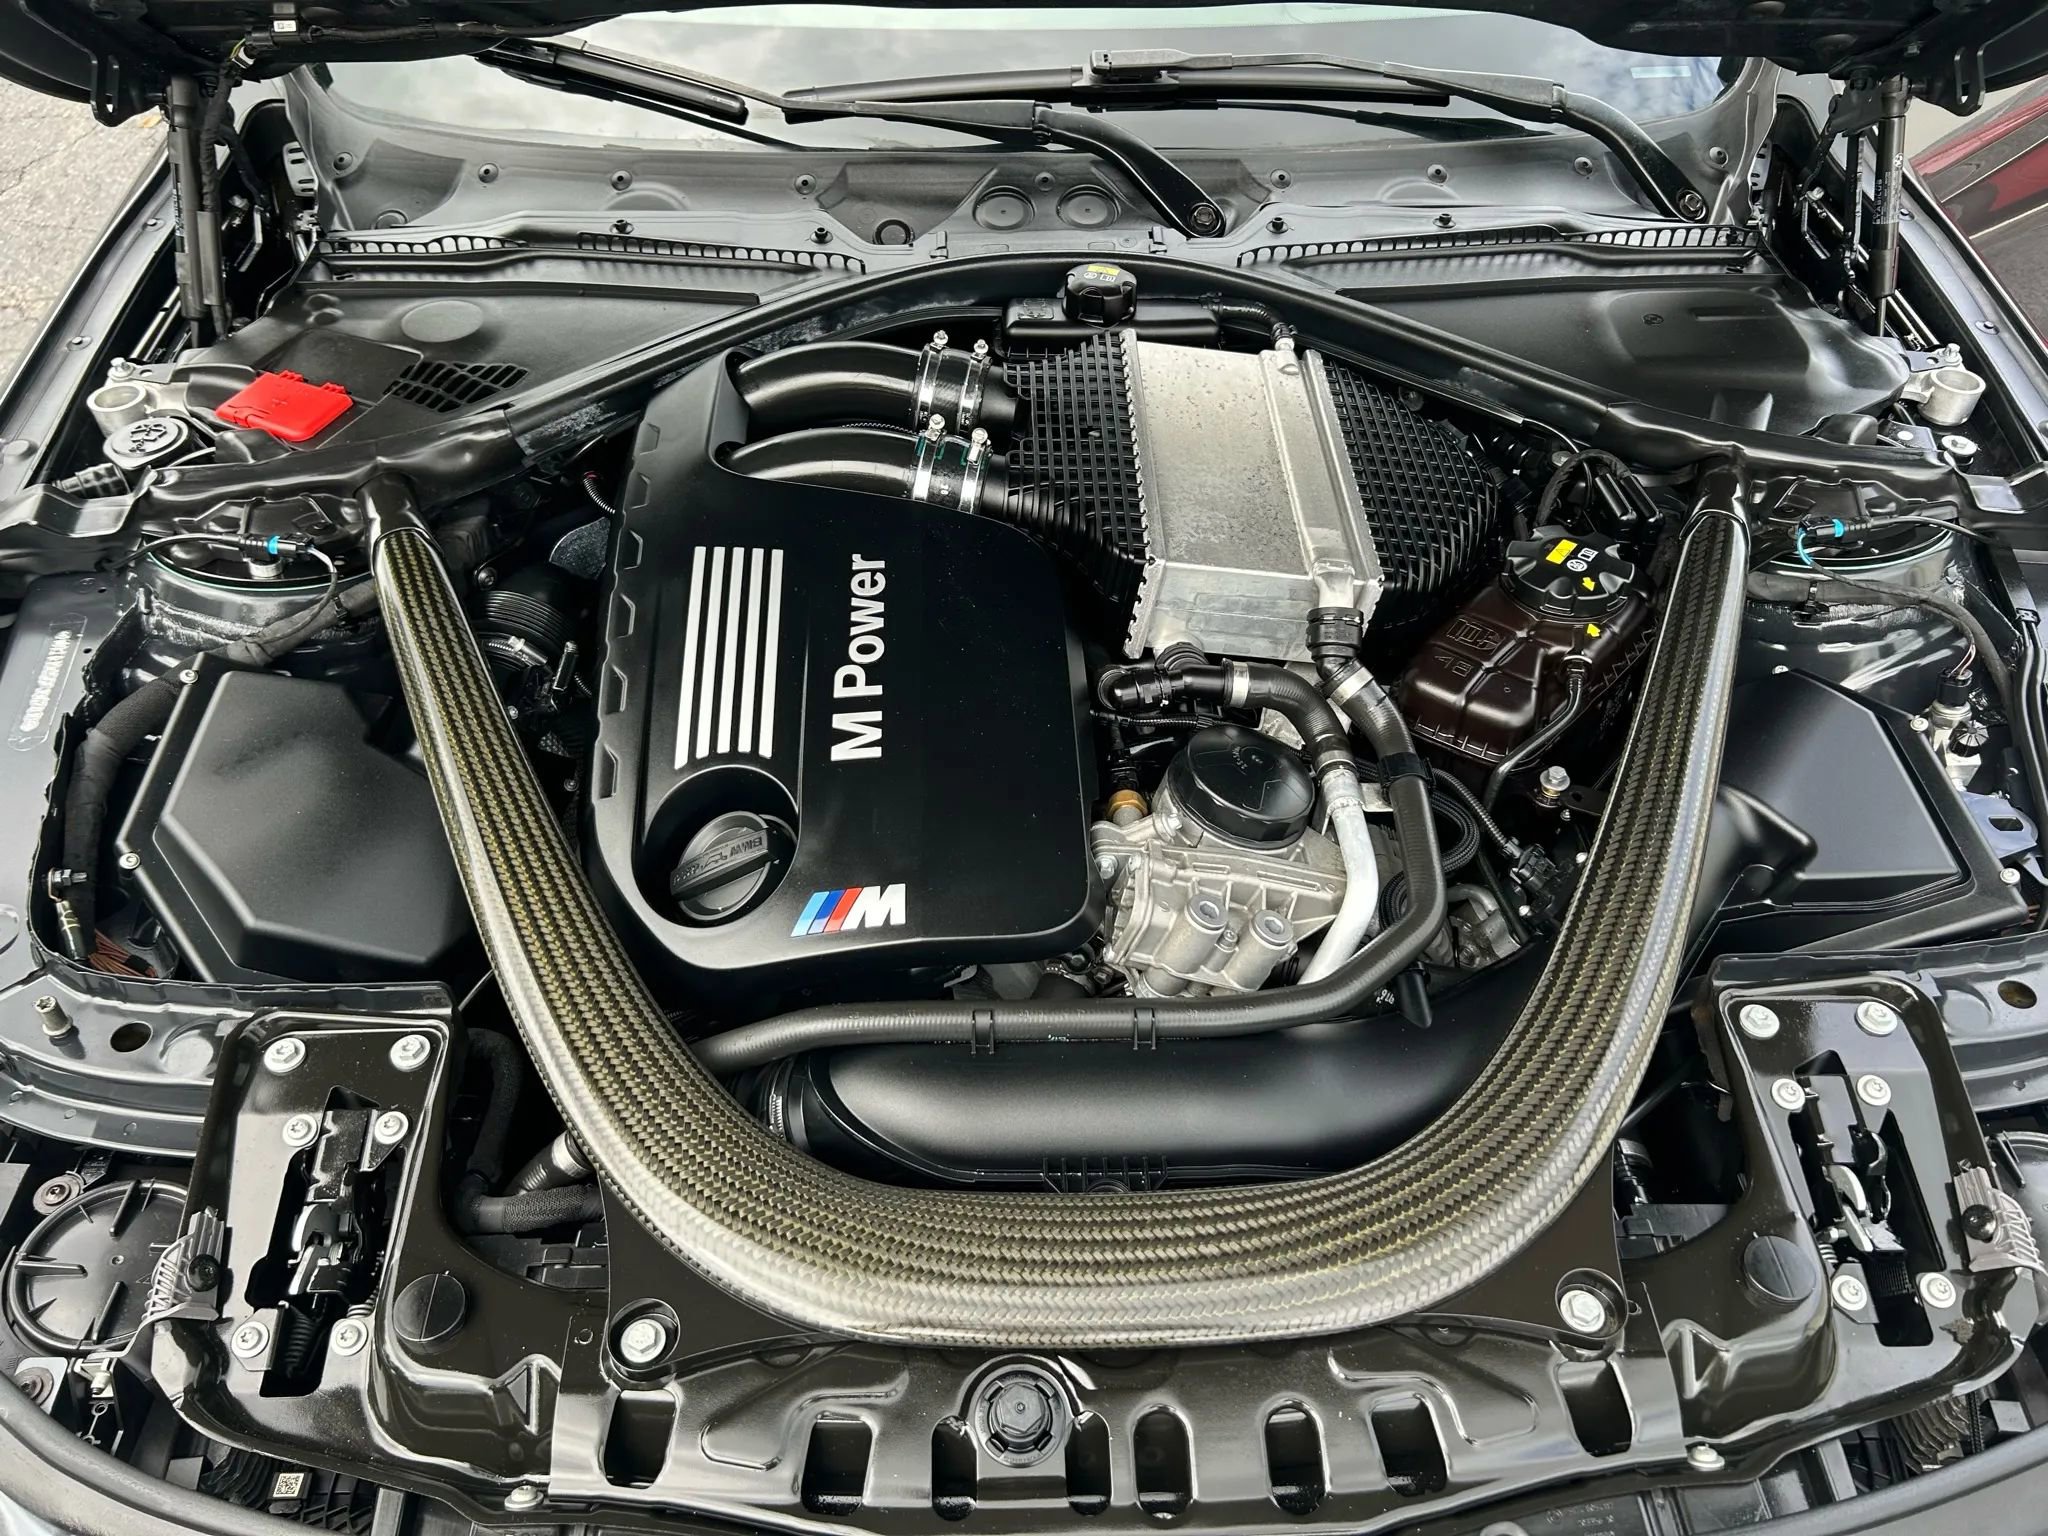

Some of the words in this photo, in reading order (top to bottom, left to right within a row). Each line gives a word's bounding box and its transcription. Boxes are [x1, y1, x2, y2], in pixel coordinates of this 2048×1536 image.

[833, 554, 886, 699] Power
[830, 711, 883, 762] M
[730, 836, 763, 857] BMW
[840, 884, 907, 929] M
